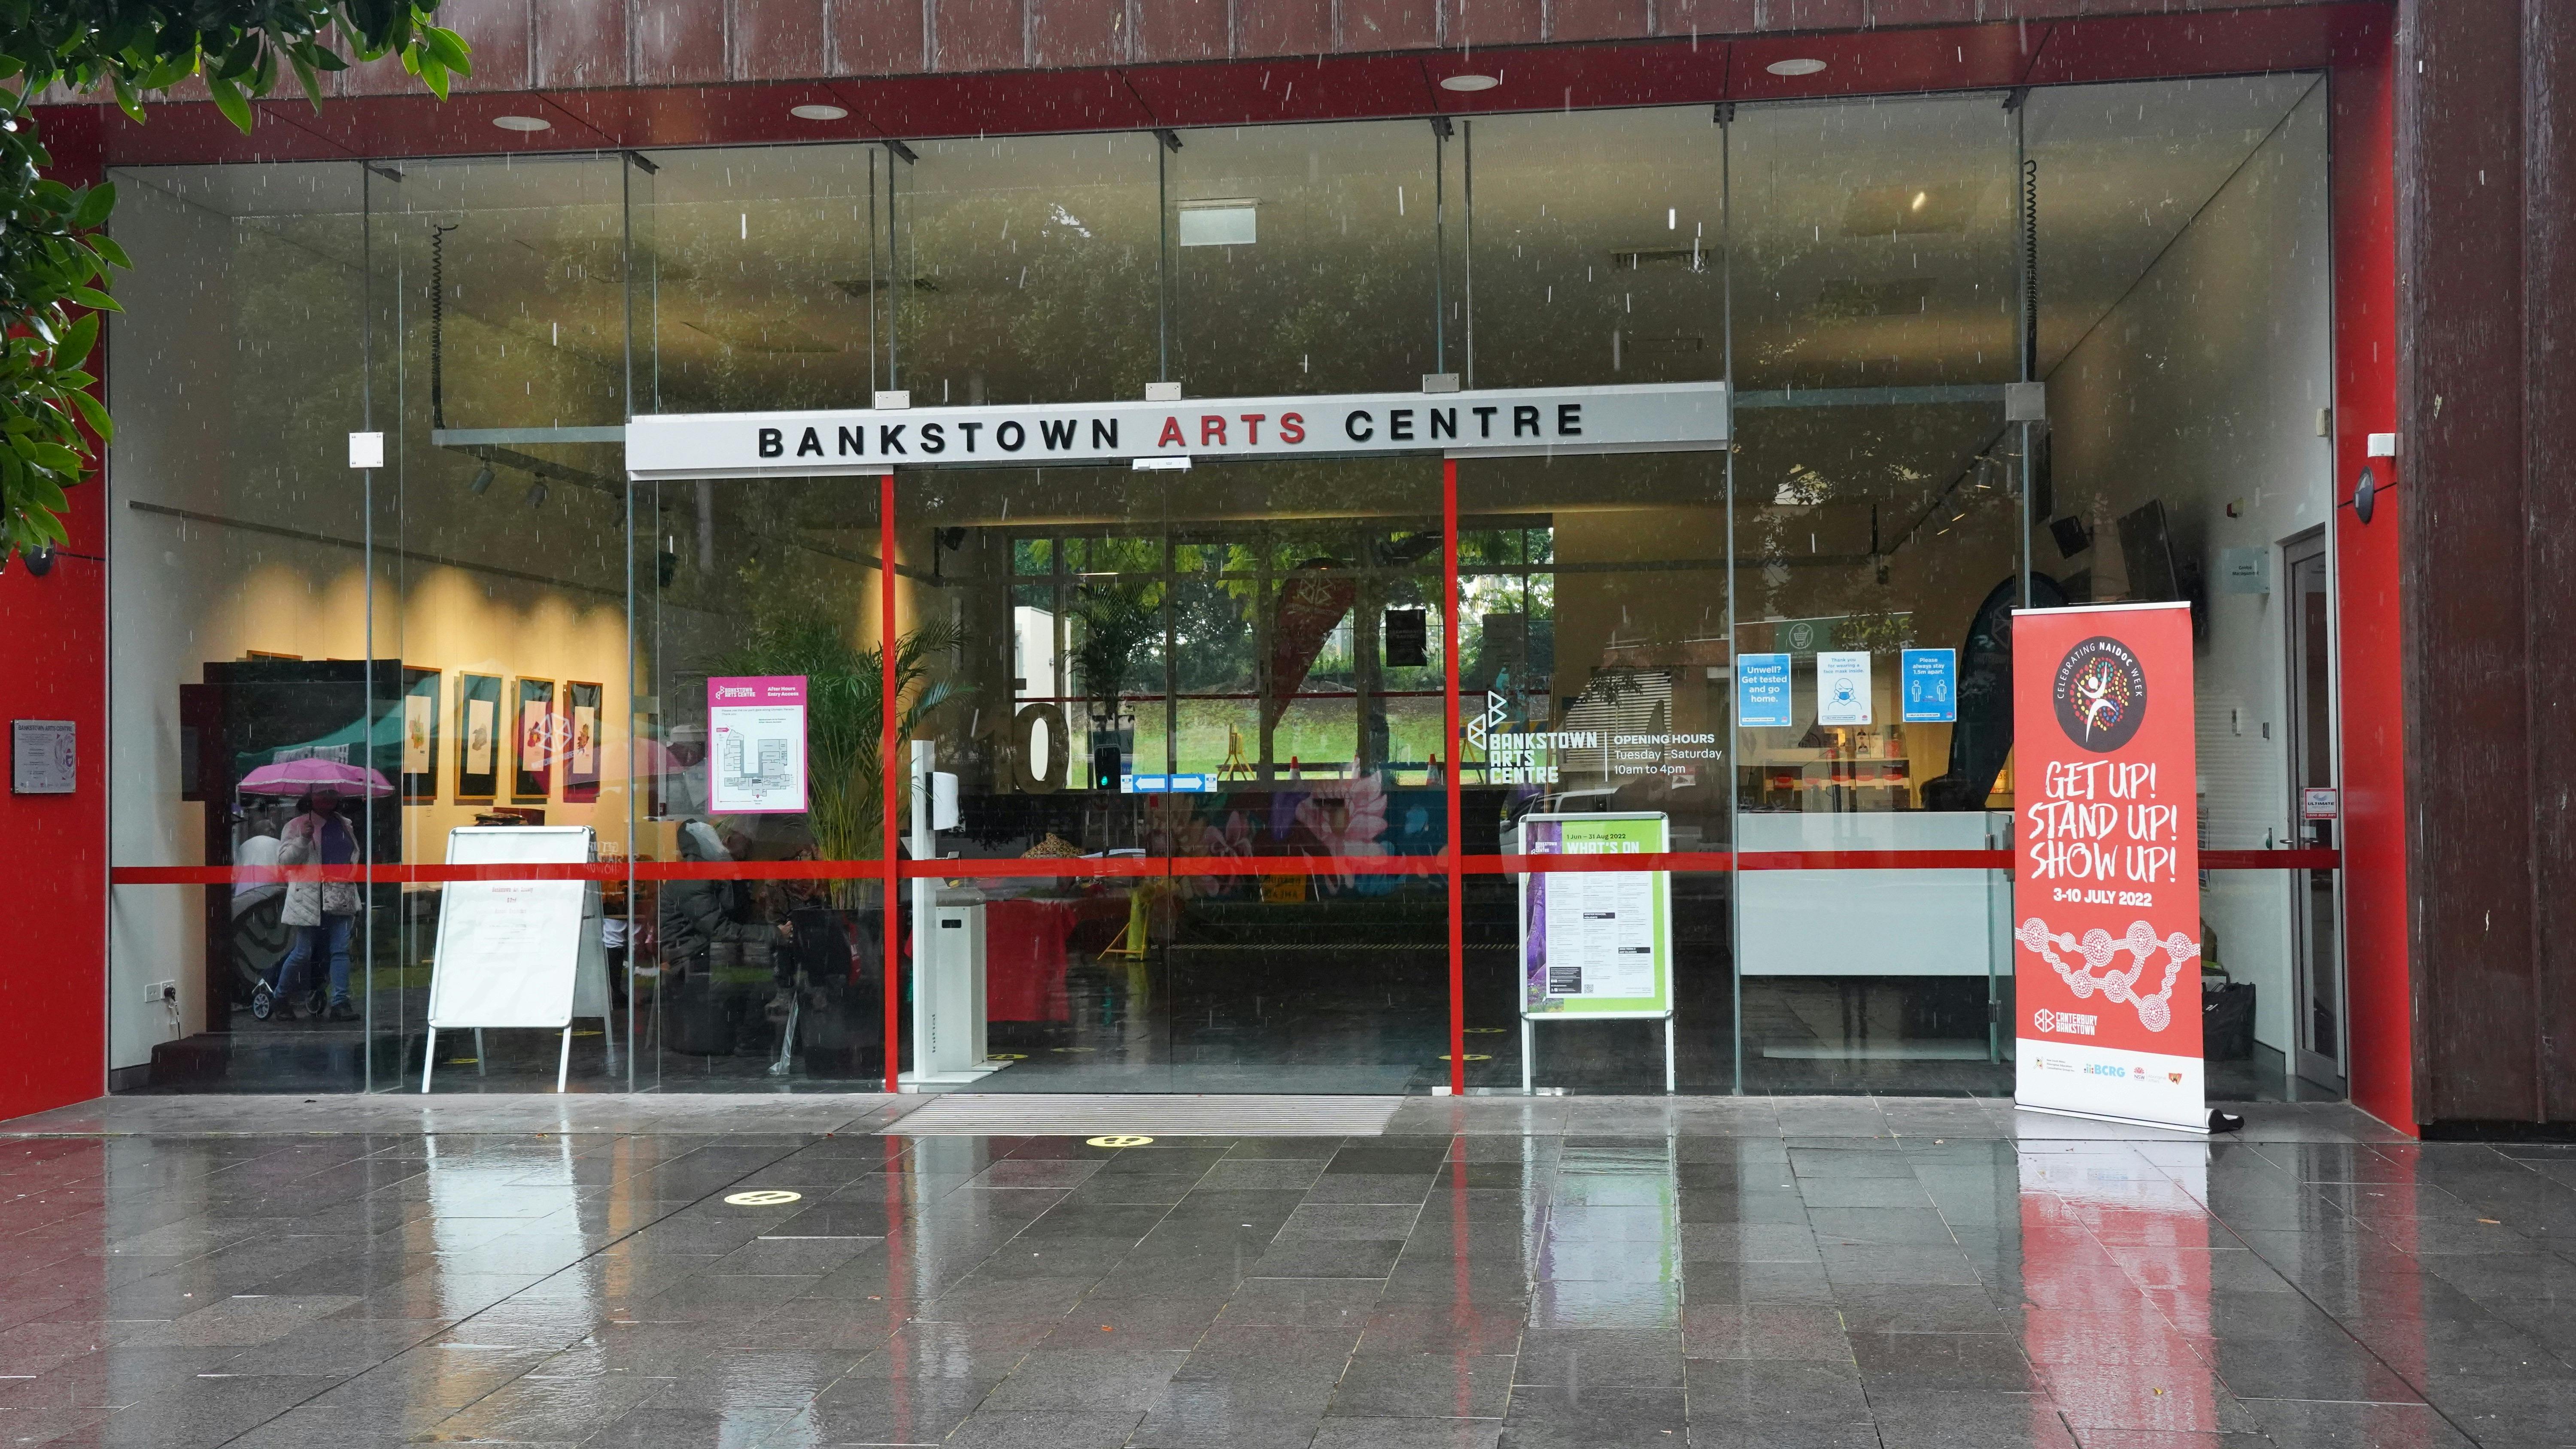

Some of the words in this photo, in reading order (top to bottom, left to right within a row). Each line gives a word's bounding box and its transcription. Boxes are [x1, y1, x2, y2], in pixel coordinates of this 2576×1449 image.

[759, 418, 1118, 457] BANKSTOWN
[1158, 412, 1305, 447] ARTS
[1345, 404, 1581, 441] CENTRE
[2057, 643, 2095, 699] CELEBRATING
[2099, 642, 2132, 667] NAIDOC
[2131, 667, 2143, 697] WEEK
[1490, 731, 1597, 751] BANKSTOWN
[1614, 734, 1670, 745] OPENING
[1672, 734, 1715, 743] HOURS
[1491, 750, 1534, 767] ARTS
[1614, 749, 1661, 761] Tuesday
[1671, 748, 1722, 760] Saturday
[1490, 766, 1558, 784] CENTRE
[1614, 765, 1643, 774] 10am
[1646, 765, 1657, 774] to
[1659, 764, 1686, 776] 4pm
[2046, 760, 2109, 800] GET
[2109, 762, 2156, 800] UP!
[2028, 800, 2118, 840] STAND
[2128, 804, 2177, 842] UP!
[1567, 842, 1618, 854] WHAT'S
[1622, 841, 1640, 854] ON
[2030, 840, 2118, 881] SHOW
[2126, 845, 2176, 883] UP!
[2054, 887, 2081, 903] 3-10
[2084, 889, 2116, 904] JULY
[2119, 891, 2152, 907] 2022
[2056, 1012, 2098, 1026] CANTERBURY
[2056, 1022, 2095, 1036] BANKSTOWN
[2094, 1064, 2125, 1078] BCRG
